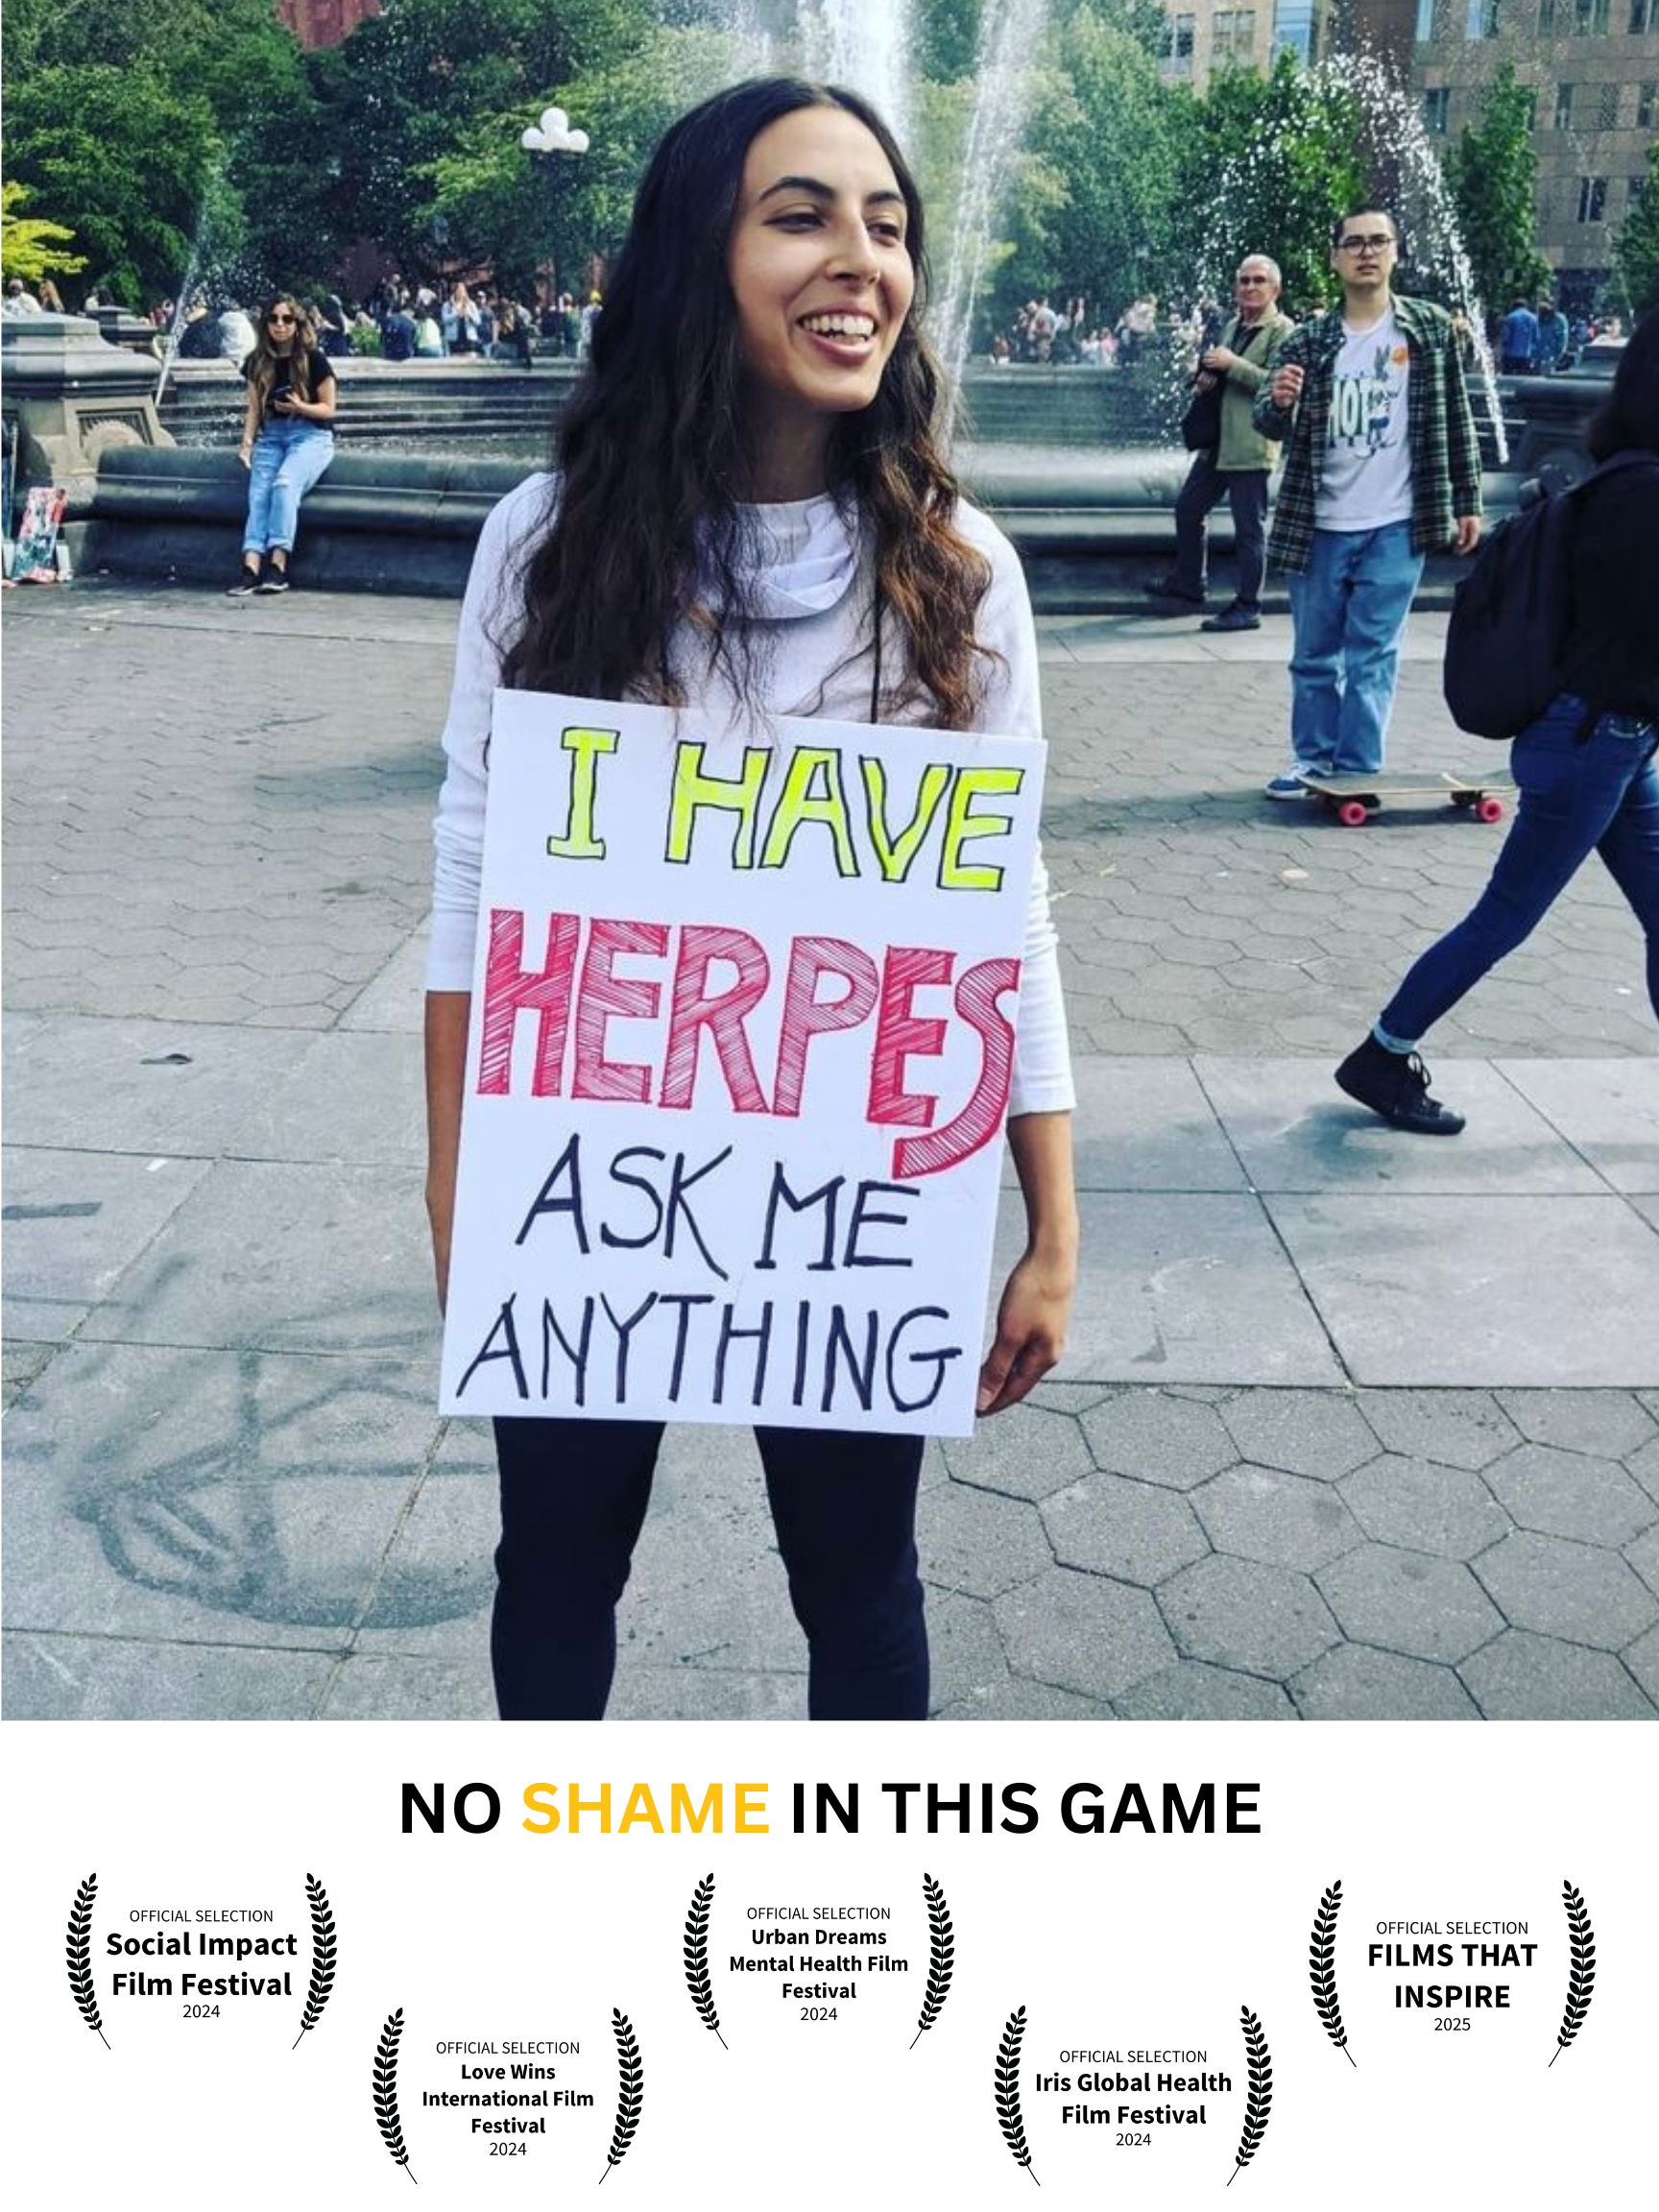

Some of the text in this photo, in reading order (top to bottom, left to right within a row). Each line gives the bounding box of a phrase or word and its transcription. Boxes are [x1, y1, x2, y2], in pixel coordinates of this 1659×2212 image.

[546, 727, 1025, 892] I HAVE
[476, 907, 1022, 1181] HERPES
[515, 1133, 920, 1281] ASK ME
[455, 1291, 963, 1412] ANYTHING
